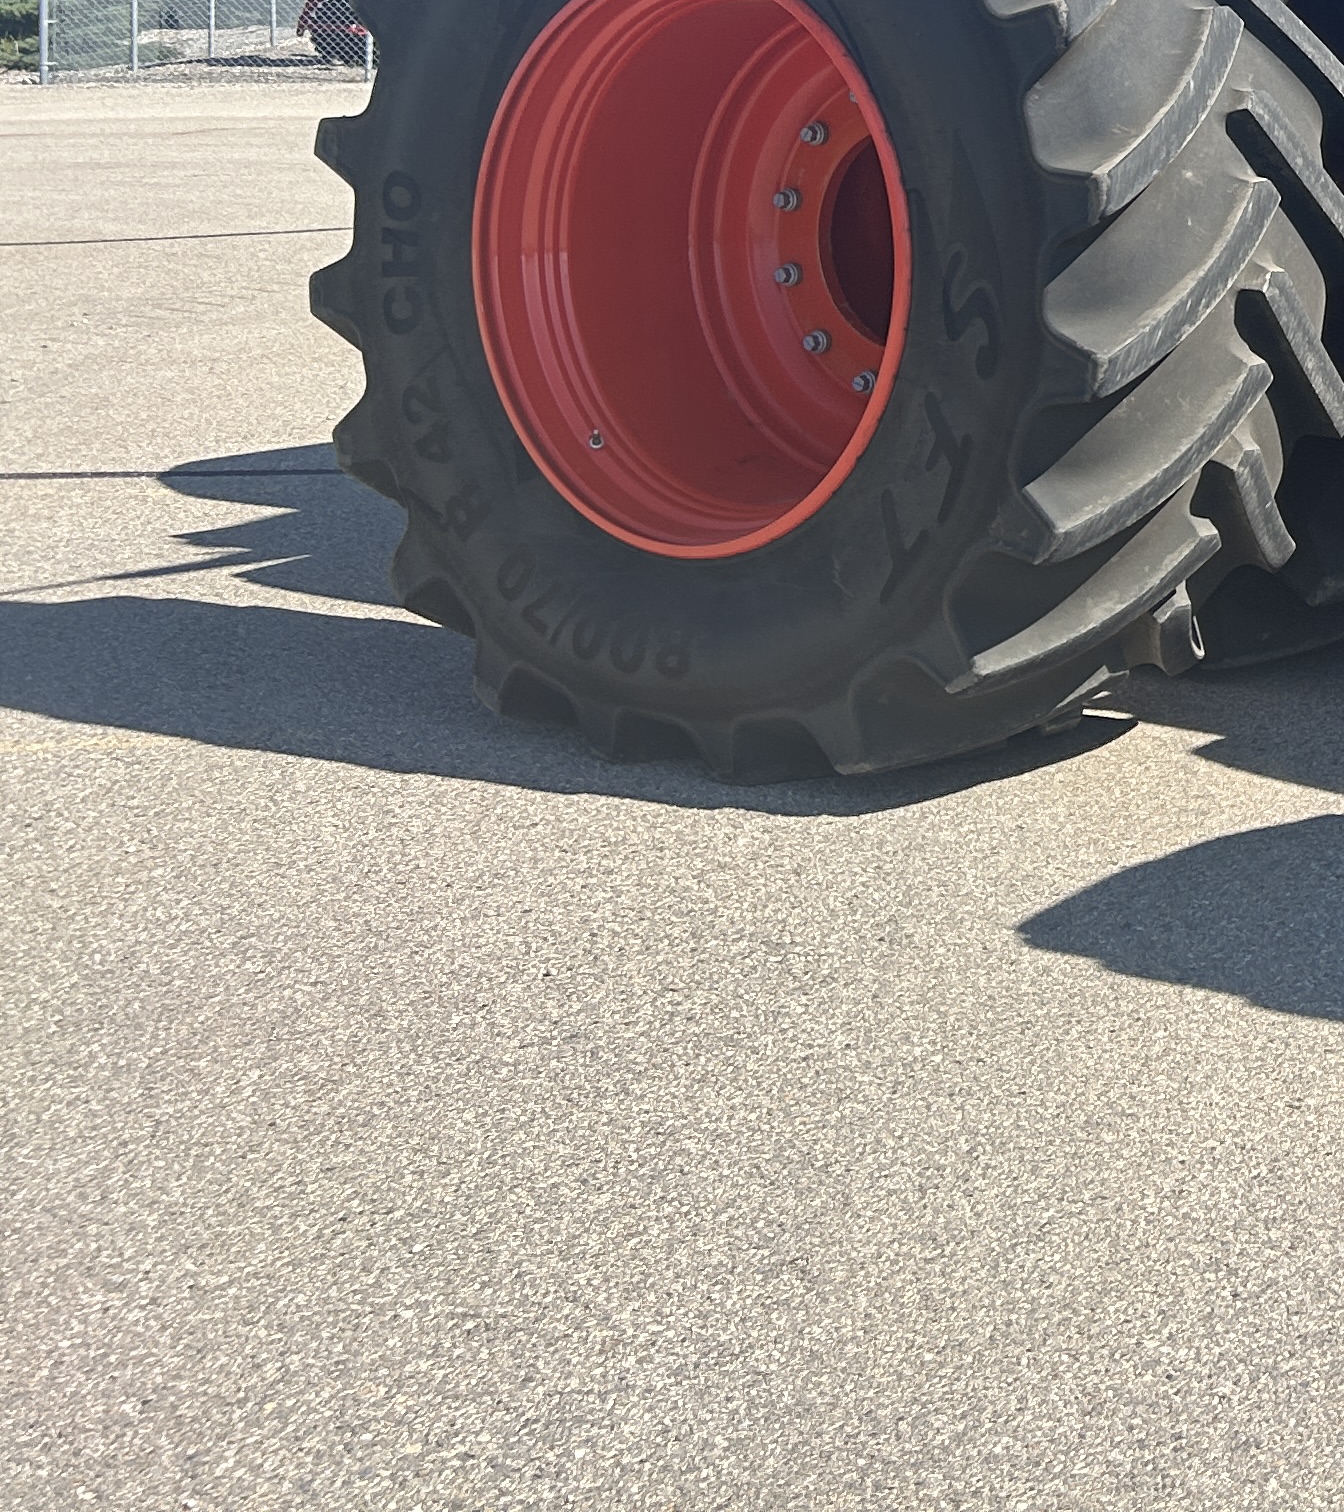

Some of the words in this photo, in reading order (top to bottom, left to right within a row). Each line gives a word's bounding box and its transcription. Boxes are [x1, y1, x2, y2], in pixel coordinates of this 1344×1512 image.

[381, 169, 423, 336] CHO
[402, 376, 452, 464] 42
[880, 251, 1001, 604] SFT
[442, 481, 493, 546] R
[496, 548, 692, 679] 800/70
